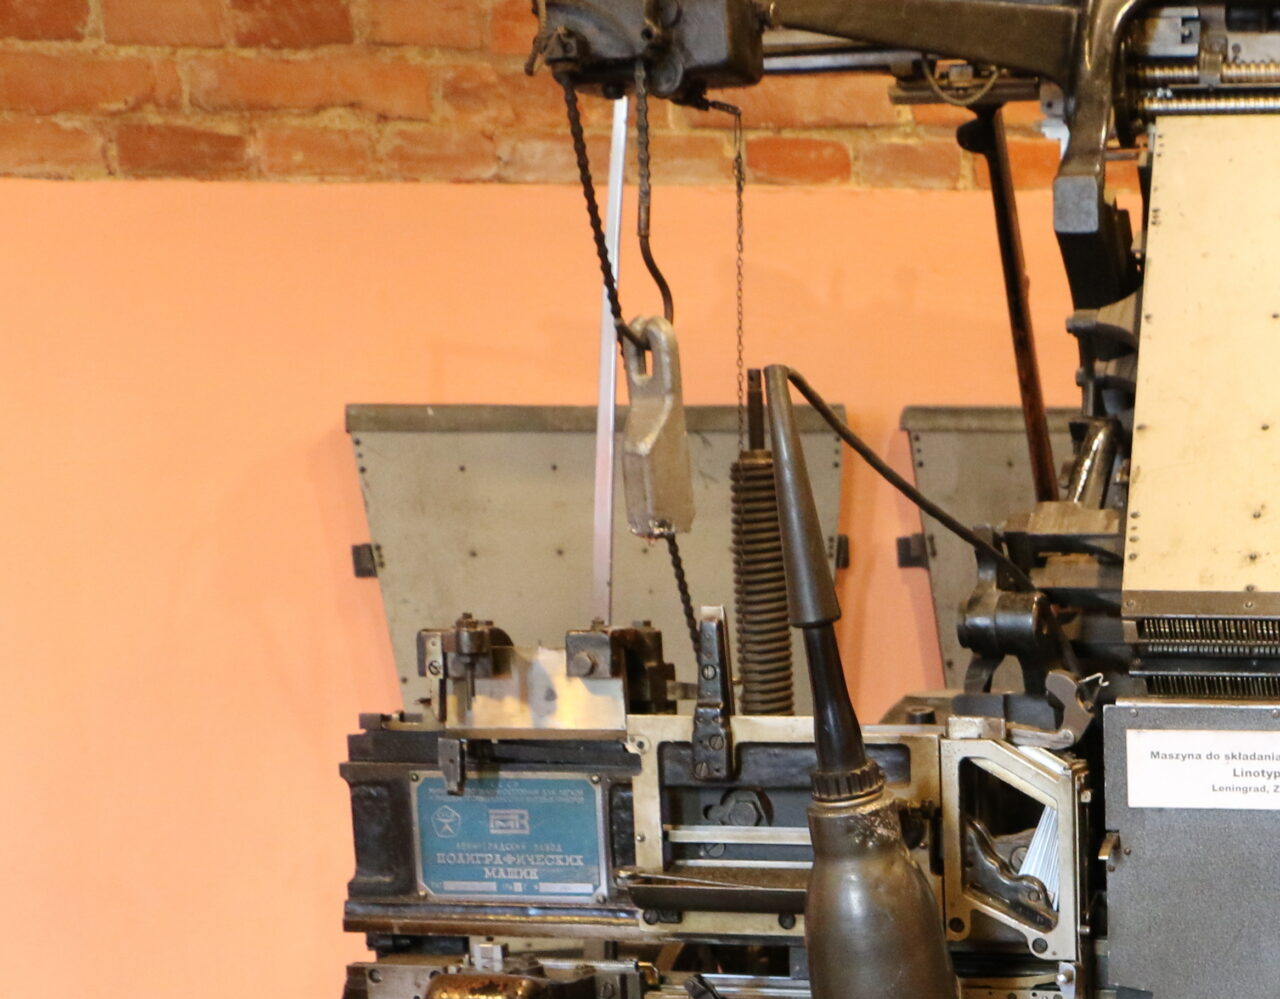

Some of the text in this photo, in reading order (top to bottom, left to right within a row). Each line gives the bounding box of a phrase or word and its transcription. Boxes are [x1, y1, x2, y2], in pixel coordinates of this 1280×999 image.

[1150, 750, 1202, 762] Maszyna
[1206, 751, 1220, 760] do
[1232, 768, 1280, 780] Linotyp
[1212, 784, 1270, 795] Leningrad,
[436, 852, 584, 866] ПОЛИГРАФИЧЕСКИХ
[484, 867, 538, 880] МАШИН
